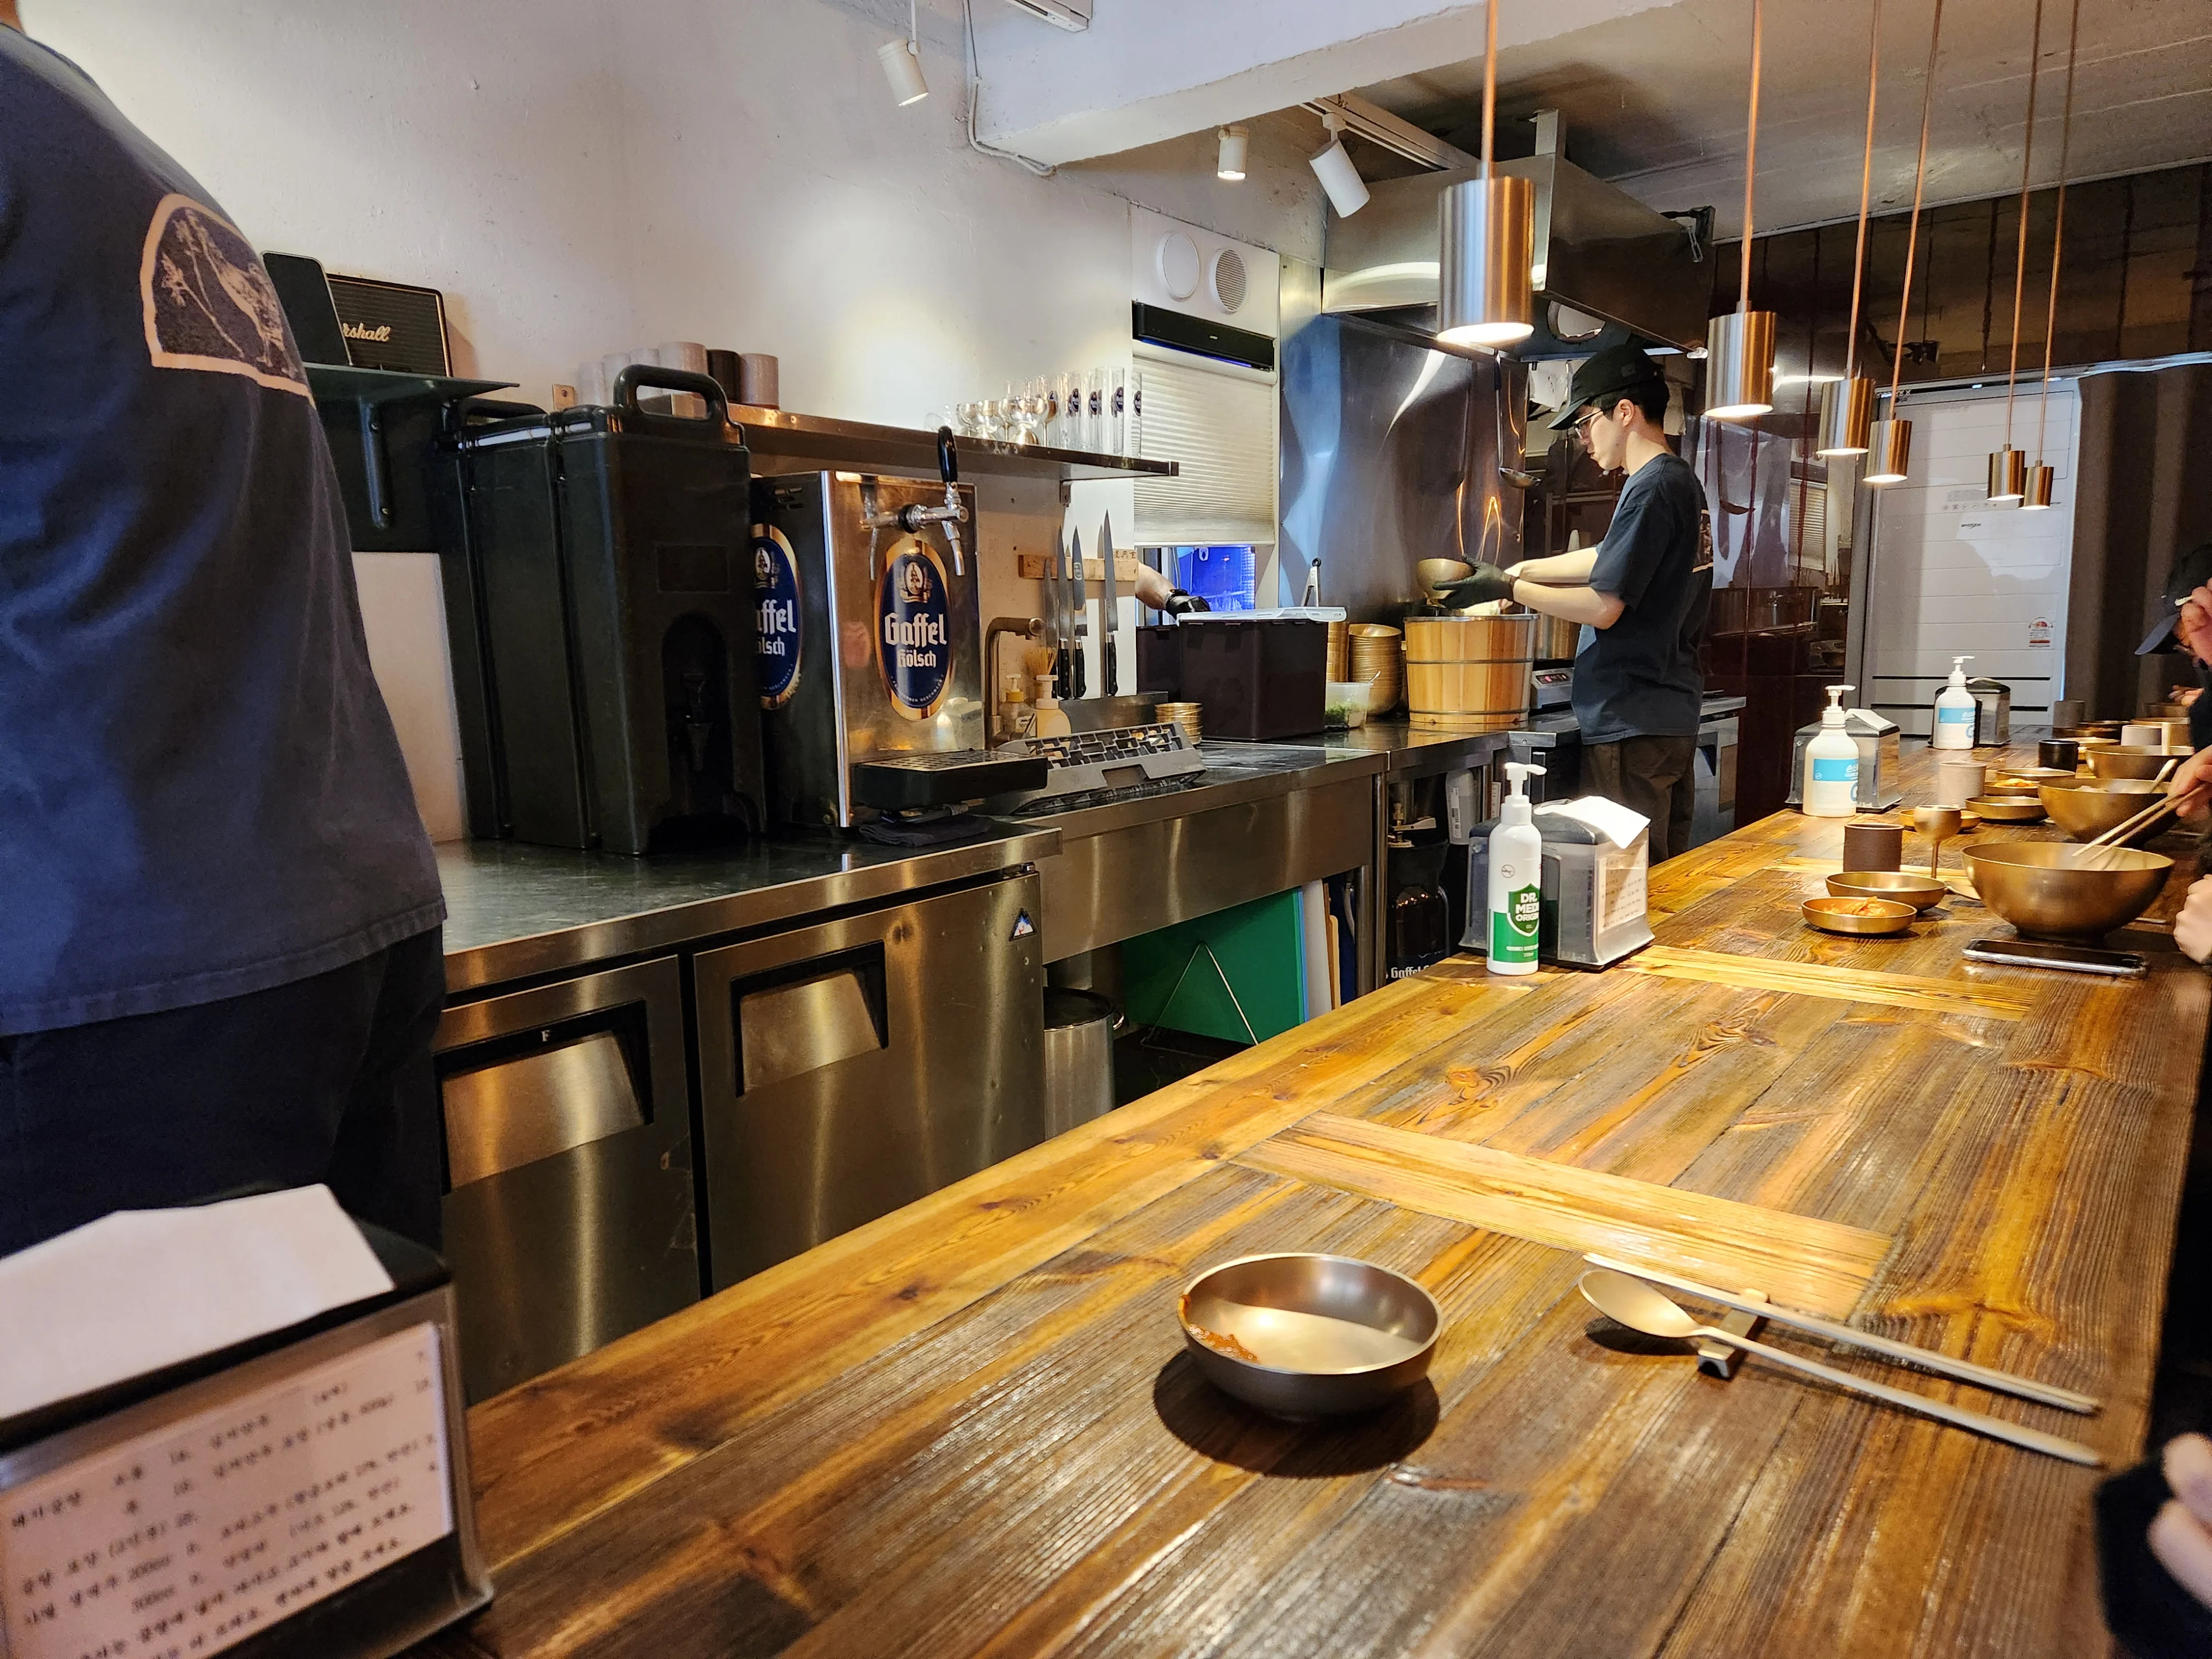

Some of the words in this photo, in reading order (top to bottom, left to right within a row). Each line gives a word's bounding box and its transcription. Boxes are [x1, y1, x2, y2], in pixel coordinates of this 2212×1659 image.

[342, 322, 391, 342] rshall
[884, 612, 947, 648] Gaffel
[896, 648, 936, 669] Kölsch
